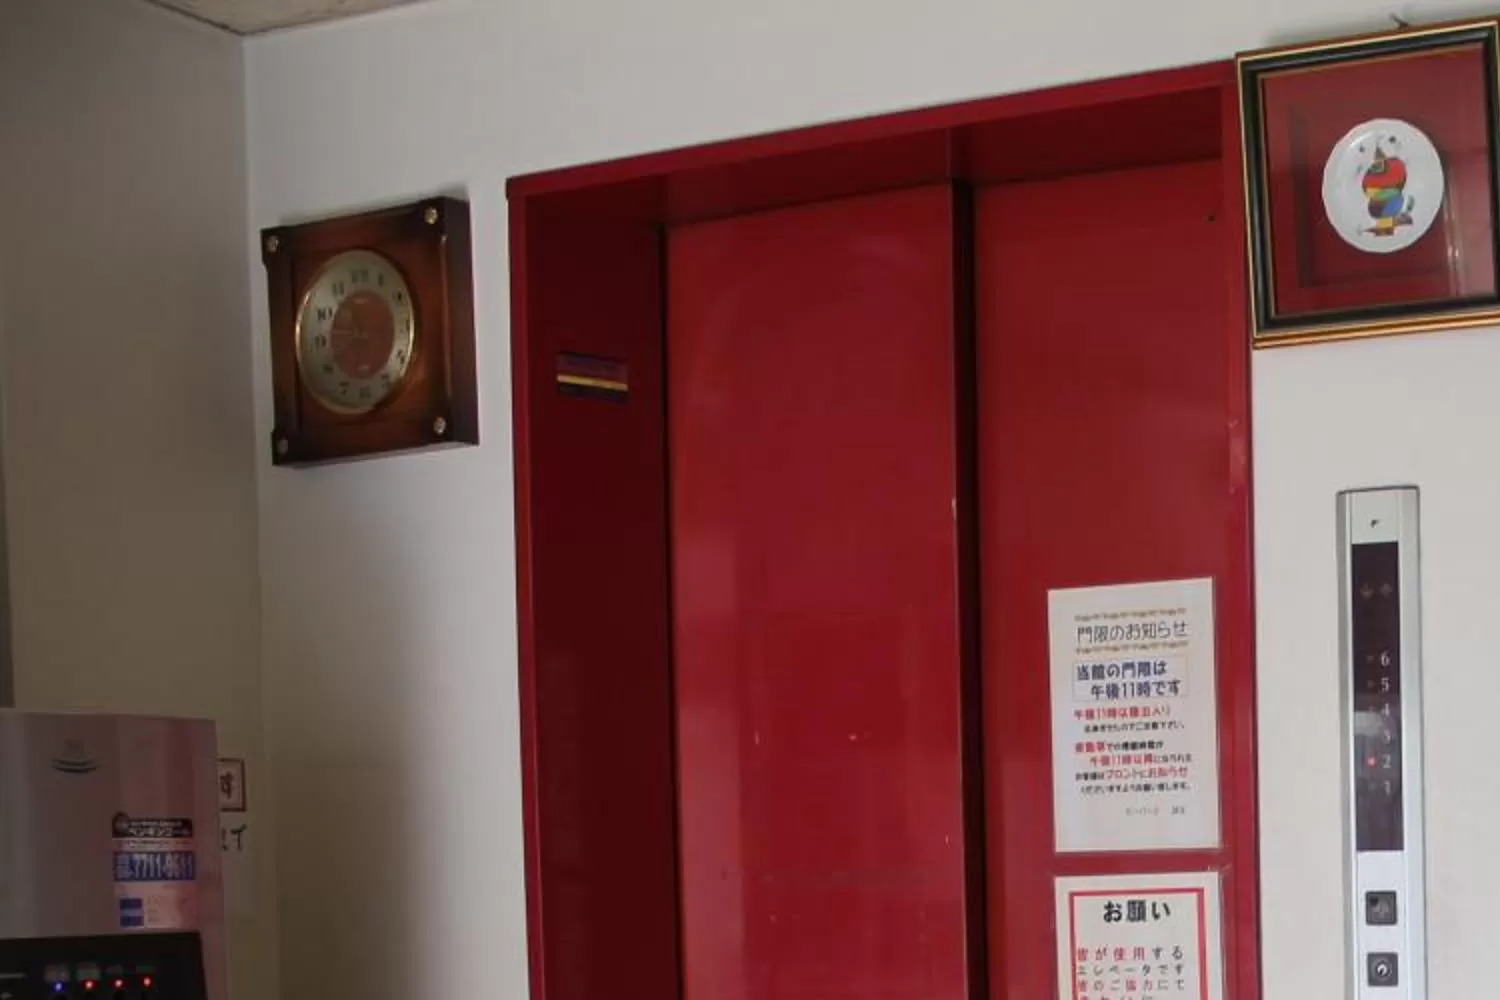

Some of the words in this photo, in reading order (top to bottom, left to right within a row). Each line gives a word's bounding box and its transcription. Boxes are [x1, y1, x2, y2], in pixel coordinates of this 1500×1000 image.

[1076, 620, 1189, 644] 門限のお知らせ
[1379, 651, 1392, 667] 6
[1090, 679, 1182, 701] 午後11時です
[1380, 677, 1391, 693] 5
[1381, 753, 1392, 769] 2
[1103, 899, 1172, 923] お願い
[1078, 963, 1184, 976] エレベータです
